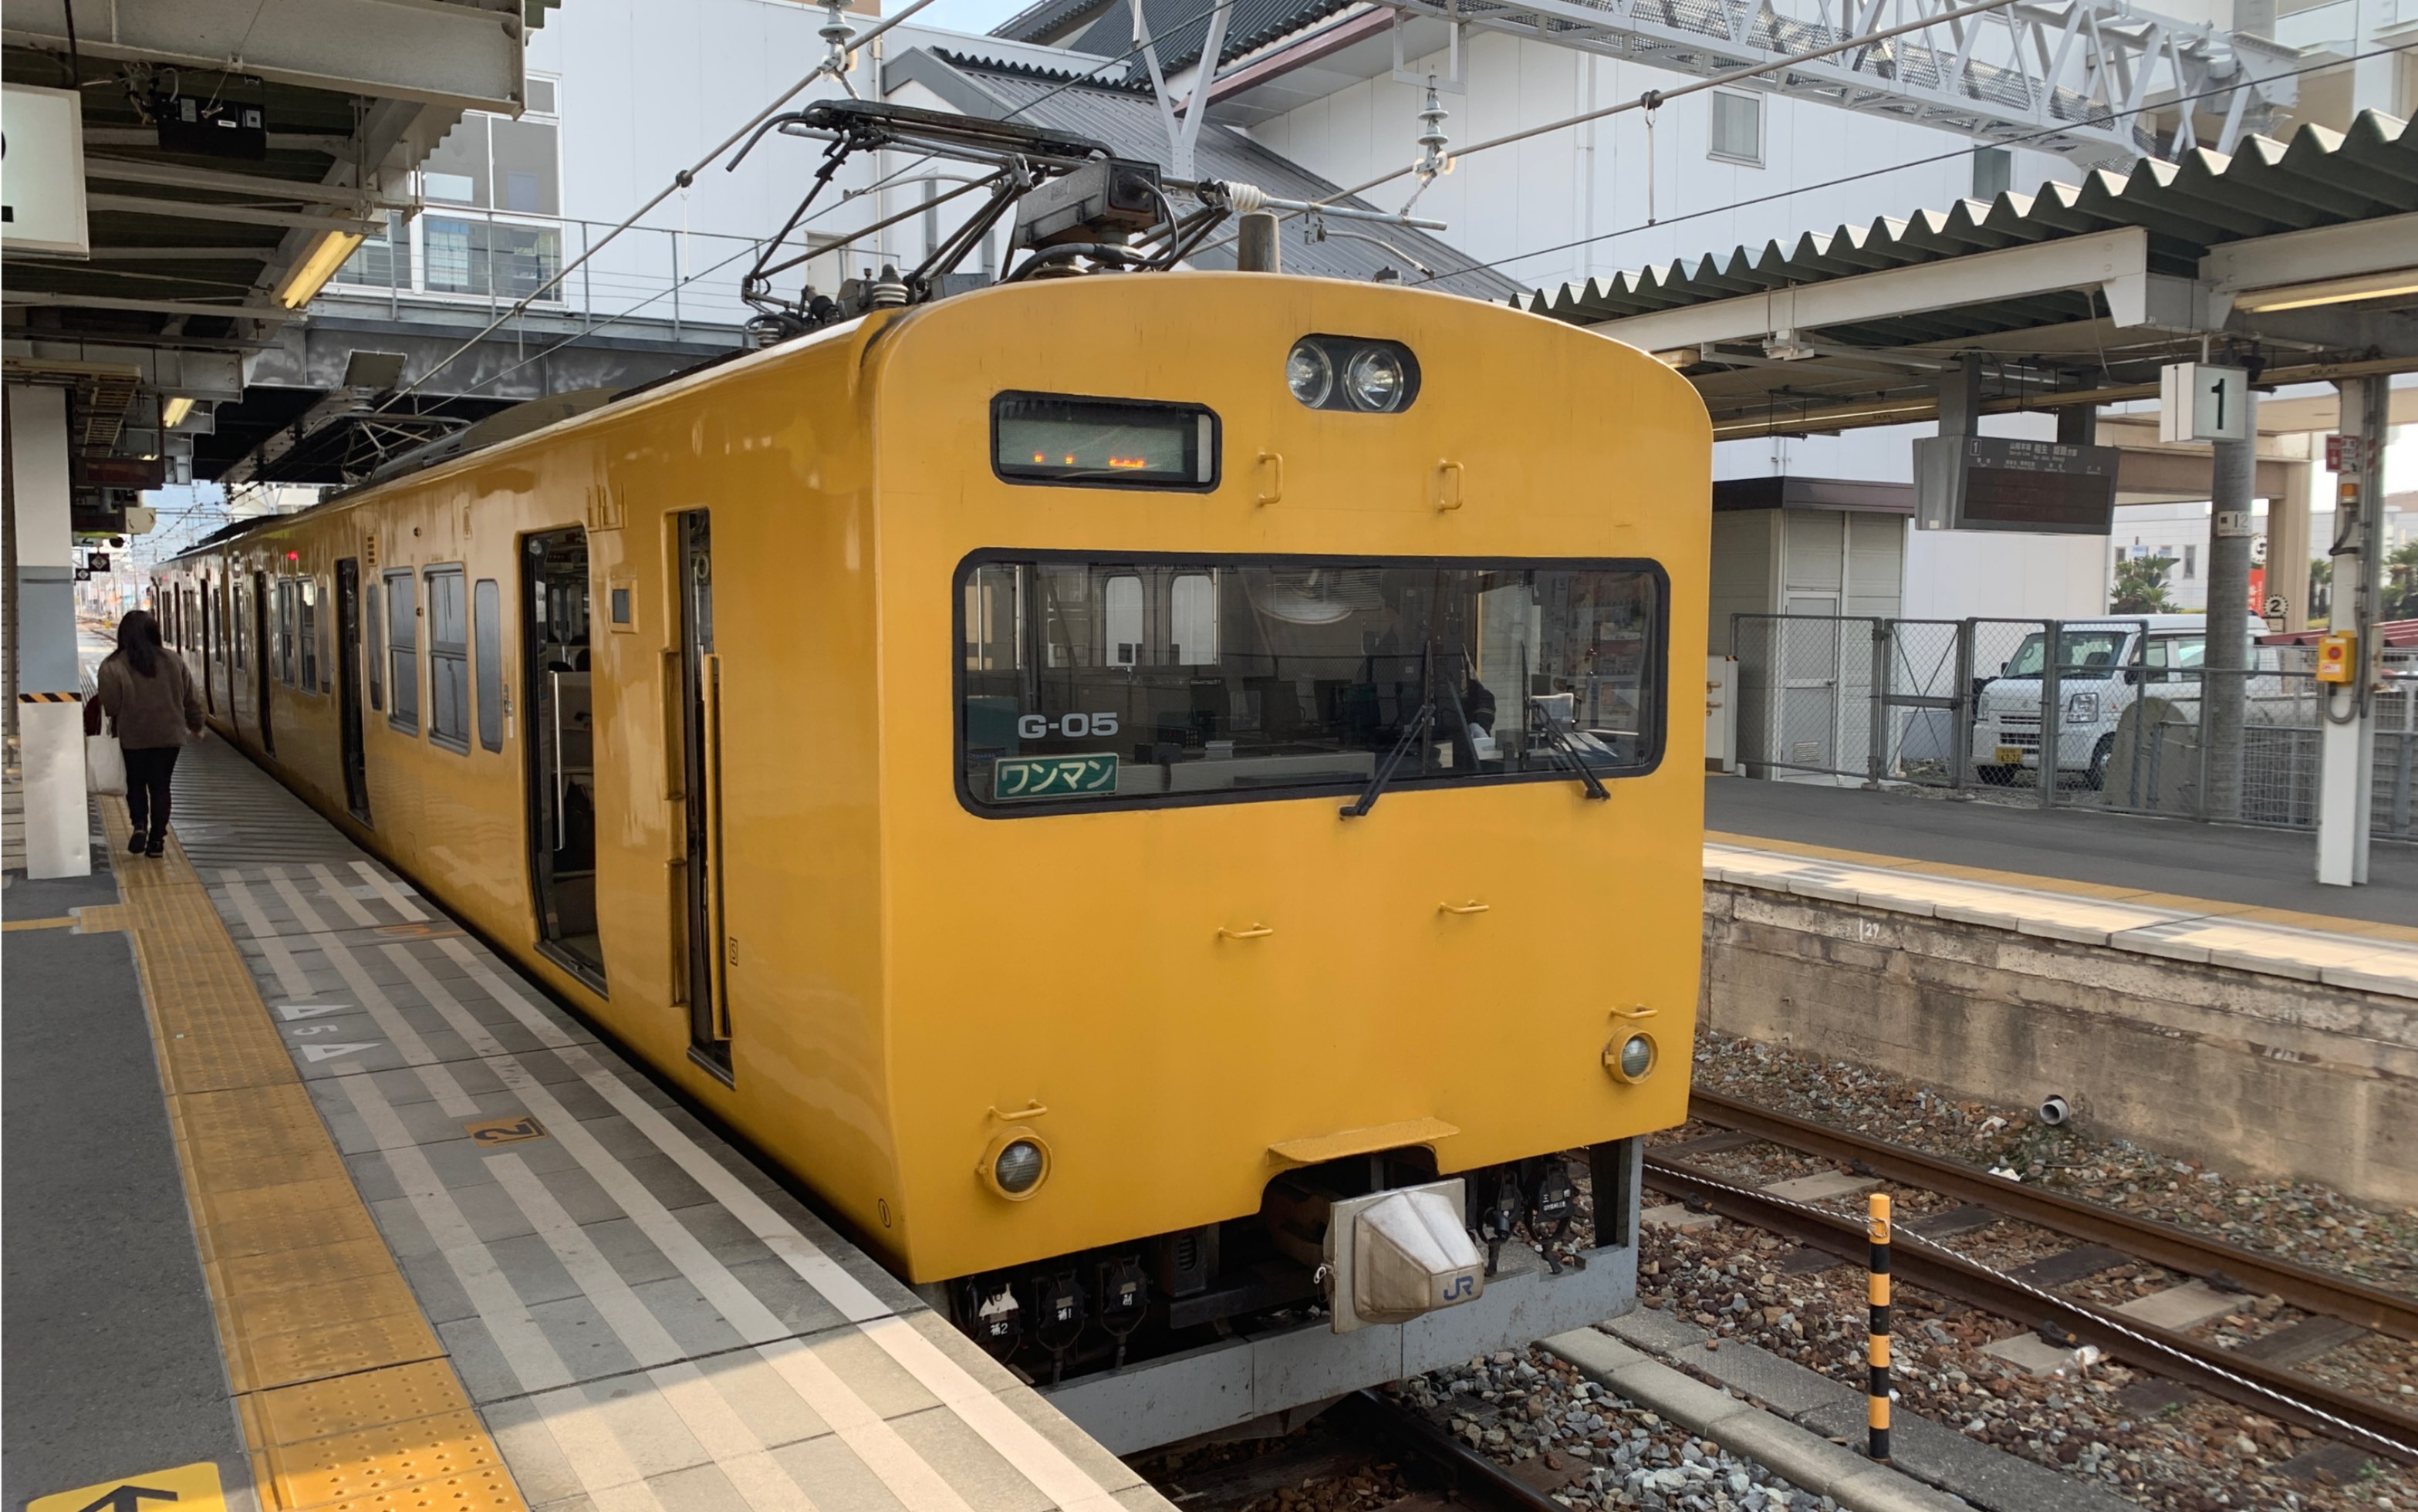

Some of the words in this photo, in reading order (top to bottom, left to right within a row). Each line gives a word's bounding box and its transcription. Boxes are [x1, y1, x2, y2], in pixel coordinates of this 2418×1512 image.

[2211, 378, 2225, 430] 1
[2234, 514, 2248, 528] 12
[2270, 599, 2281, 613] 2
[1018, 712, 1119, 739] G-05
[1001, 760, 1113, 795] ワンマン
[293, 1024, 339, 1036] 5
[1444, 1275, 1474, 1301] JR
